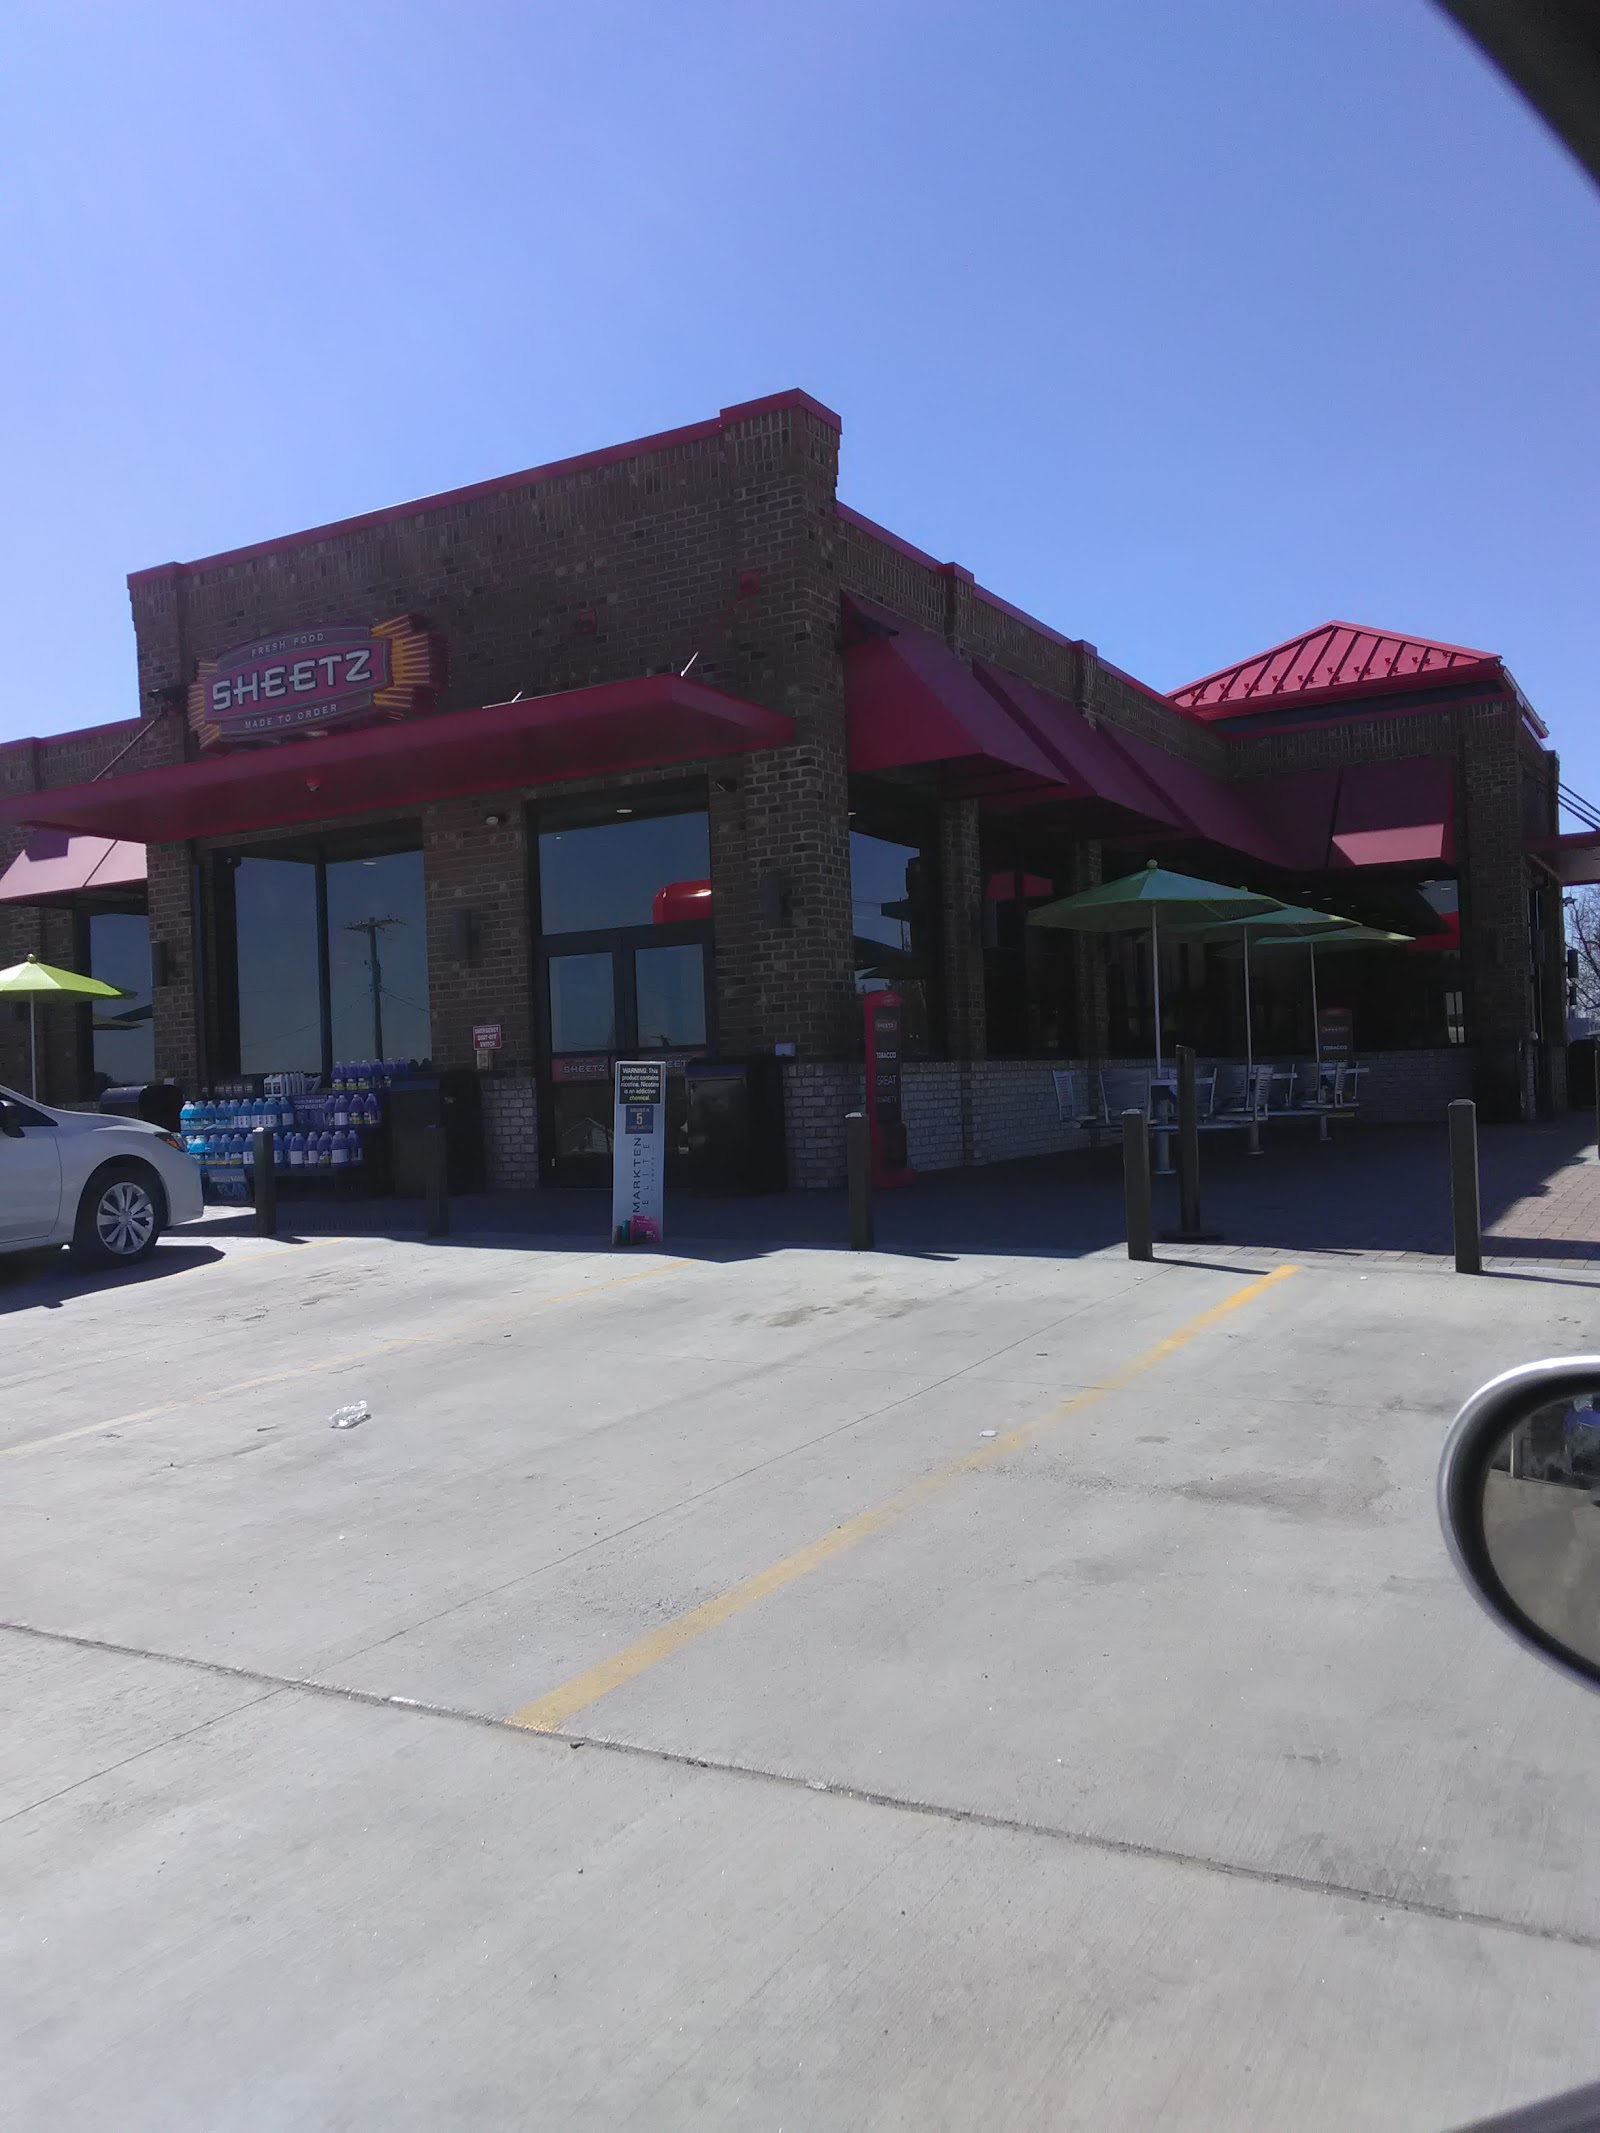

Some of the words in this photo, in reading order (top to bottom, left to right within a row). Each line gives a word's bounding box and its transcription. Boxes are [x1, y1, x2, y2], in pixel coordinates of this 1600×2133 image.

[251, 640, 286, 657] FRESH
[293, 632, 325, 646] FOOD
[212, 649, 371, 711] SHEETZ
[245, 716, 273, 729] MADE
[278, 714, 291, 724] TO
[298, 704, 338, 720] ORDER
[875, 1051, 897, 1059] TOBACCO
[564, 1064, 605, 1074] SHEETZ
[876, 1074, 897, 1086] GREAT
[636, 1112, 643, 1125] 5
[632, 1137, 642, 1213] MARKTEN
[642, 1143, 651, 1205] ELITE
